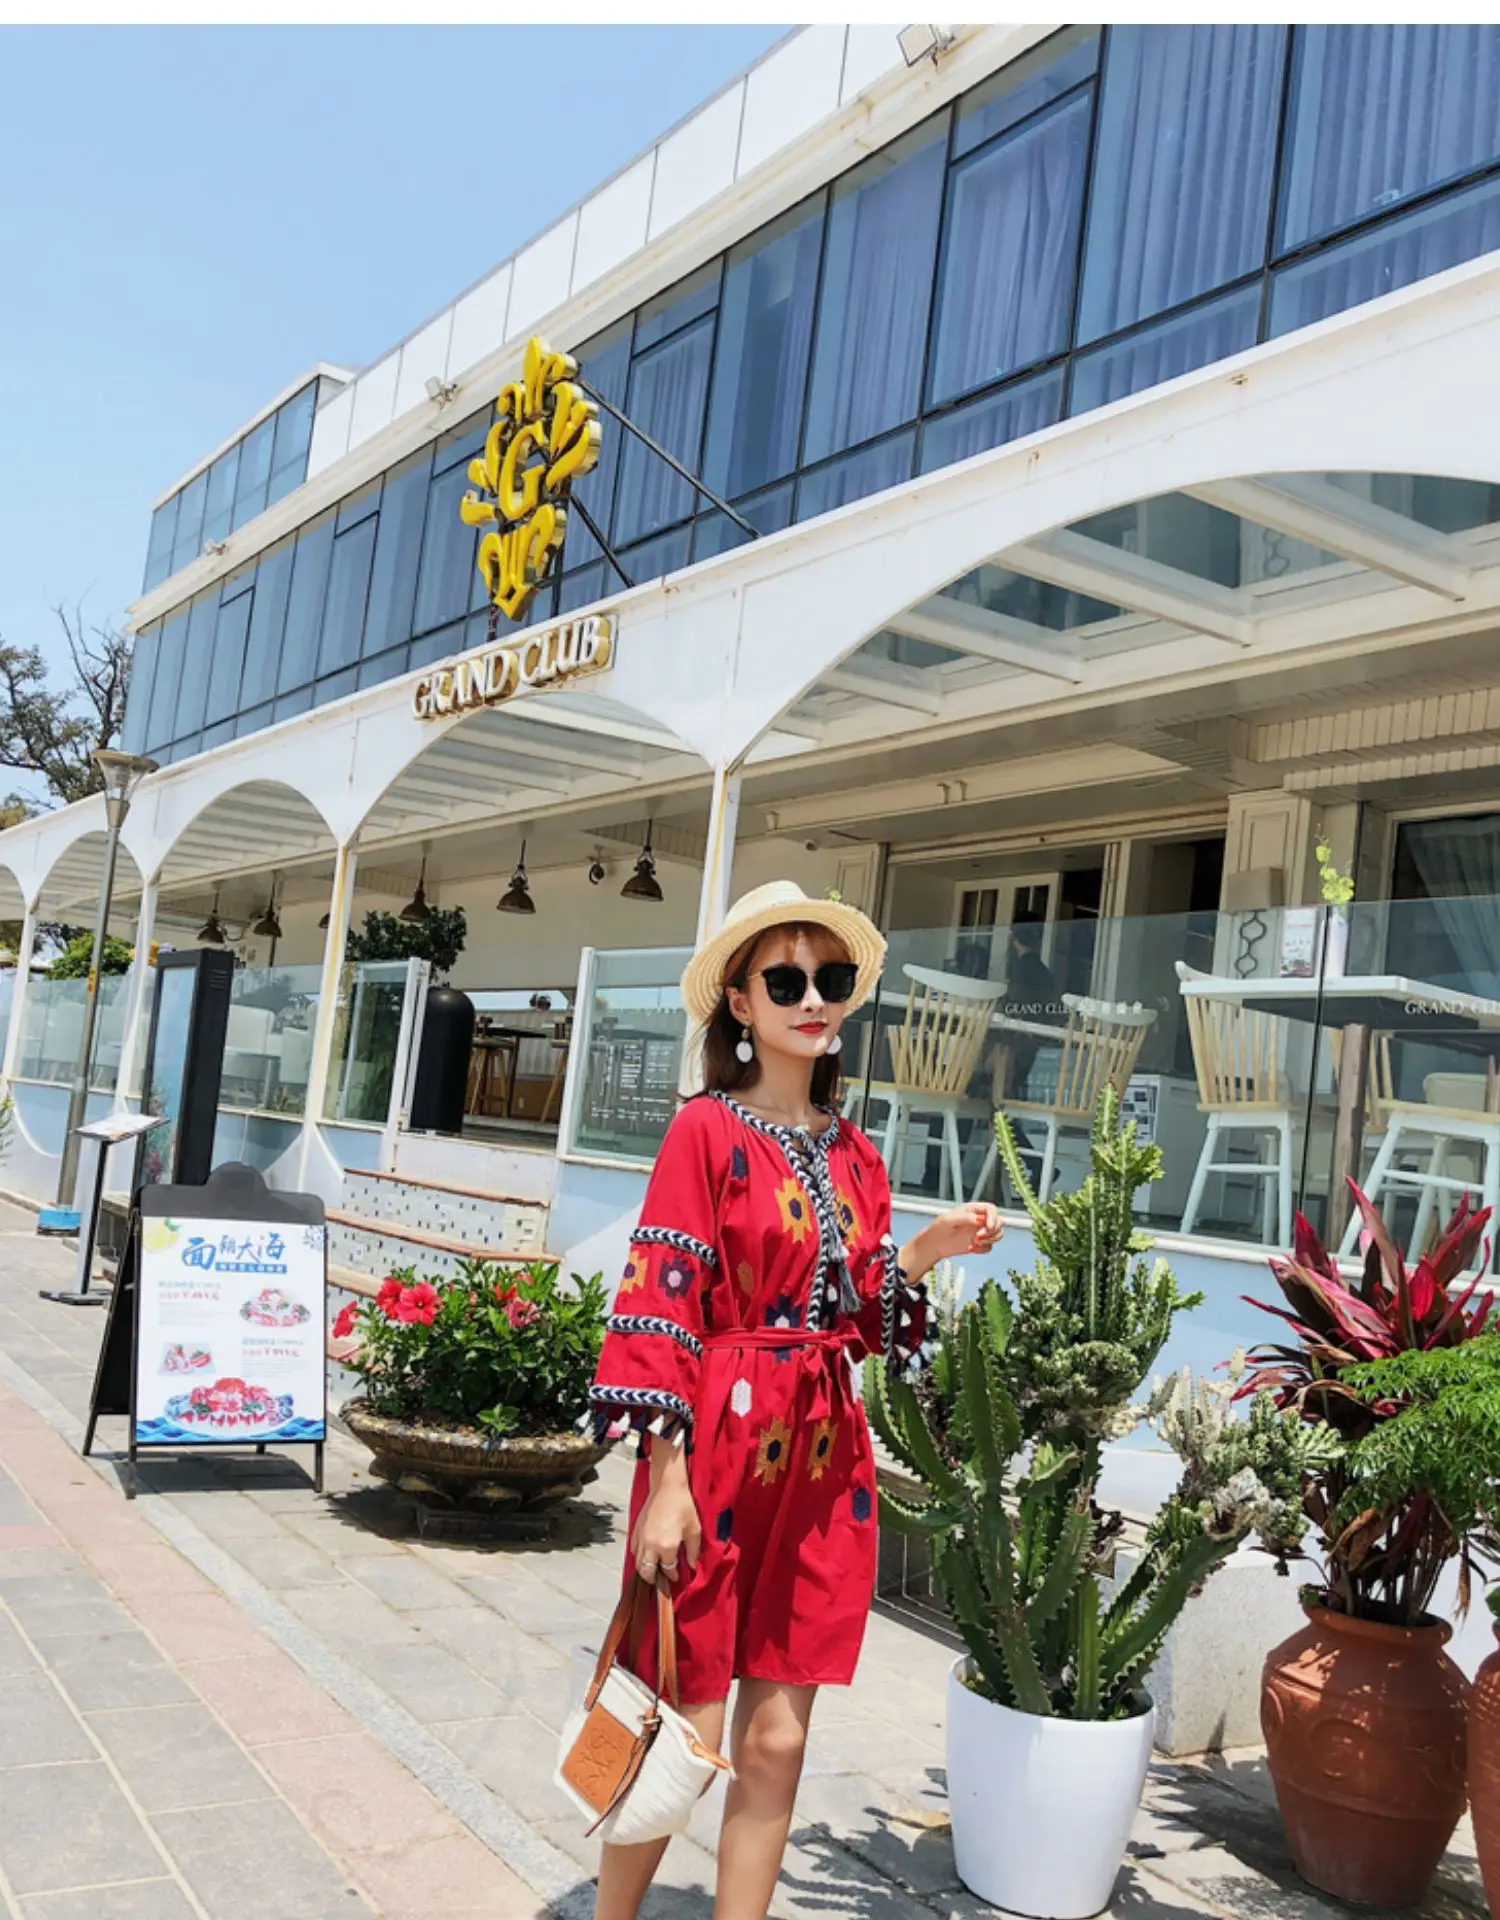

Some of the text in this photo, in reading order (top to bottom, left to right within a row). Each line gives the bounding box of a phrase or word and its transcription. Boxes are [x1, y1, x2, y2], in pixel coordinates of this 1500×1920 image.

[411, 616, 608, 719] GRAND CLUB
[1005, 1003, 1042, 1015] GRAND
[1045, 1003, 1074, 1015] CLU
[1404, 1000, 1464, 1015] GRAND
